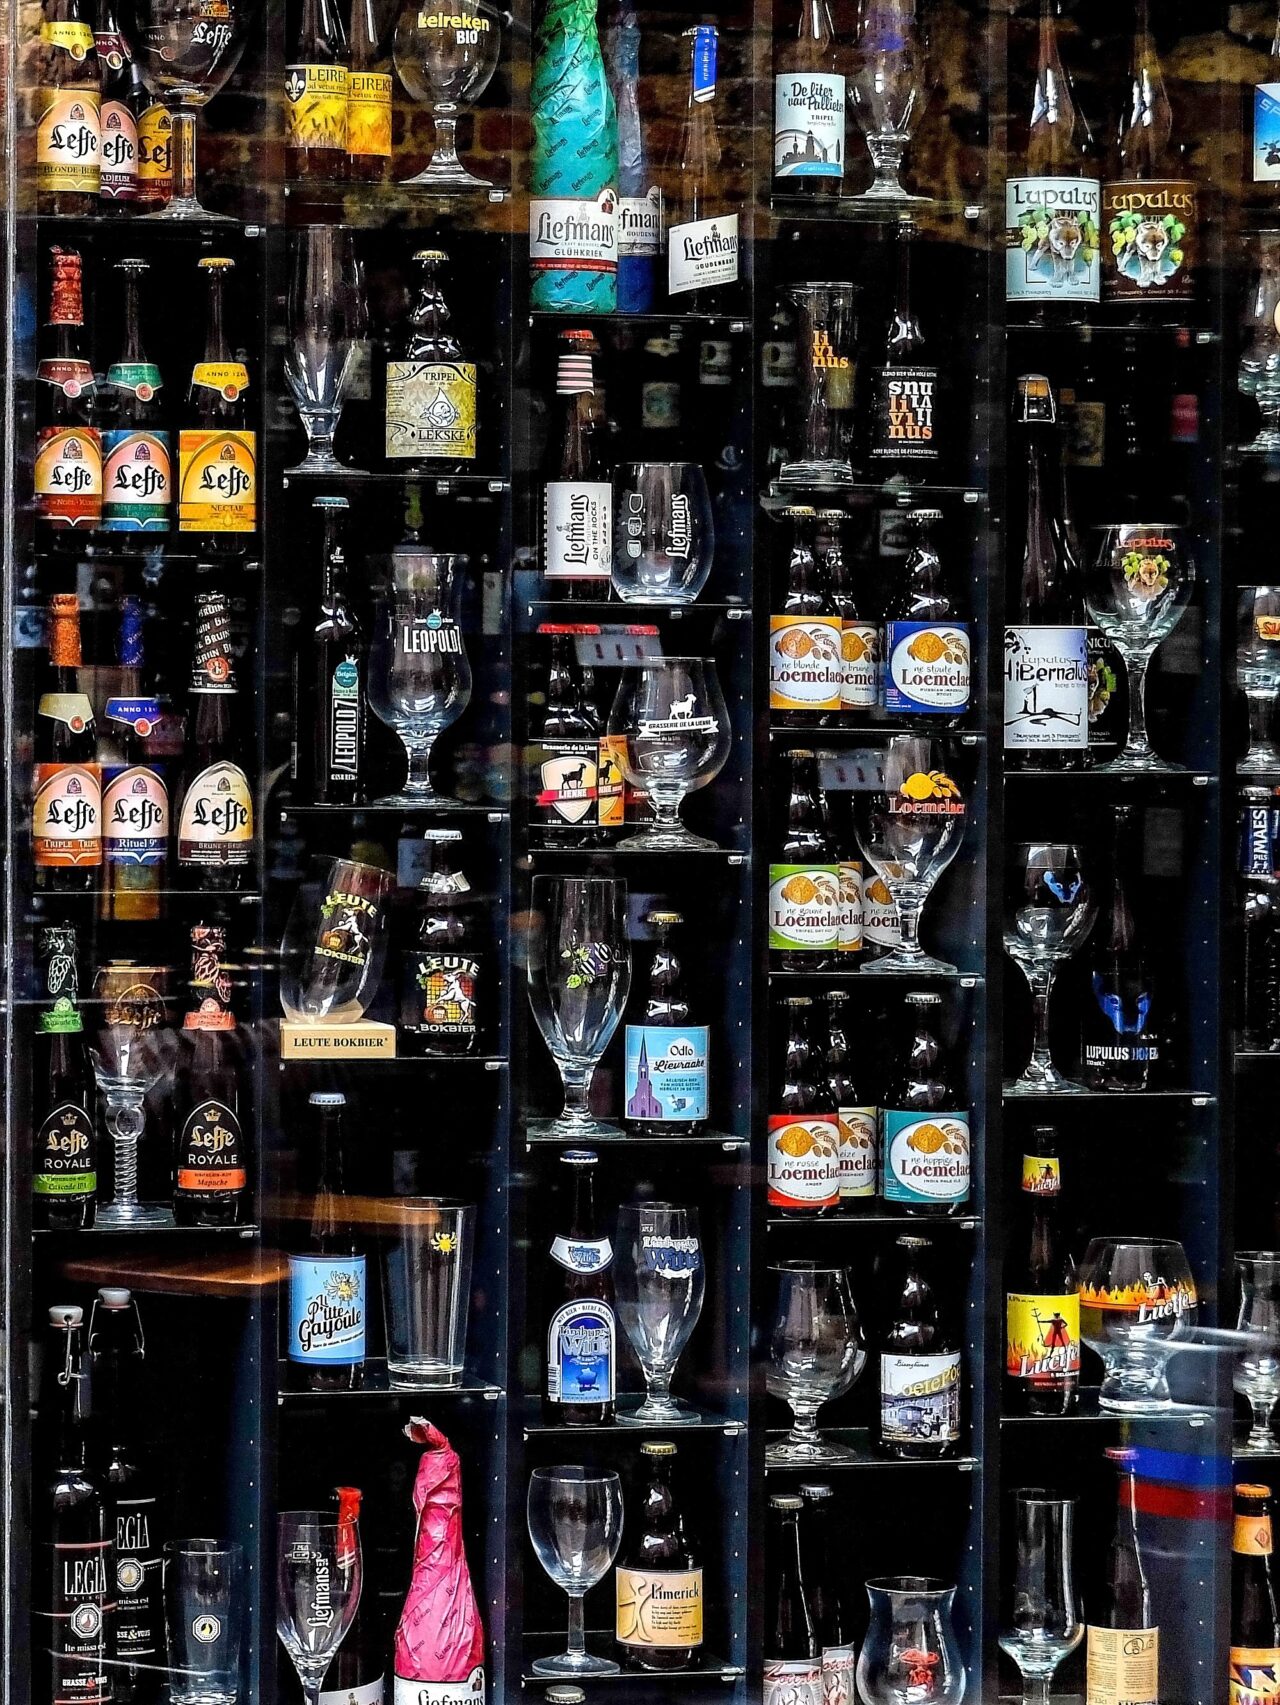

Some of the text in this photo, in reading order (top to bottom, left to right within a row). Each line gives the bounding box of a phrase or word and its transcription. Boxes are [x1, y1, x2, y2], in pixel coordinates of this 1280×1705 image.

[190, 21, 232, 50] Leffe
[456, 29, 478, 45] BIO
[790, 81, 834, 98] De liter
[787, 96, 807, 108] van
[48, 123, 98, 159] Leffe
[1013, 183, 1098, 212] Lupulus
[535, 212, 614, 250] Liefmans
[554, 247, 603, 258] GLÜHKRIEK
[423, 372, 458, 382] TRIPEL
[418, 429, 466, 442] LEKSKE
[49, 464, 93, 493] Leffe
[112, 464, 168, 497] Leffe
[199, 463, 252, 499] Leffe
[563, 494, 589, 565] Liefmans
[665, 493, 688, 559] Liefmans
[591, 546, 598, 560] ON
[793, 659, 820, 669] blonde
[927, 664, 952, 674] stoute
[110, 798, 164, 832] Leffe
[888, 797, 966, 814] Loemelaer
[46, 798, 97, 833] Leffe
[191, 798, 249, 835] Leffe
[1251, 808, 1269, 853] MAES
[119, 838, 148, 848] Rituel
[325, 892, 378, 919] LEUTE
[314, 947, 366, 966] BOKBIER
[418, 954, 481, 977] LEUTE
[419, 1022, 477, 1033] BOKBIER
[294, 1037, 331, 1047] LEUTE
[670, 1045, 694, 1056] Odlo
[1086, 1045, 1129, 1060] LUPULUS
[47, 1131, 90, 1157] Leffe
[188, 1124, 235, 1155] Leffe
[44, 1158, 91, 1169] ROYALE
[187, 1154, 238, 1165] ROYALE
[651, 1581, 700, 1600] Limerick
